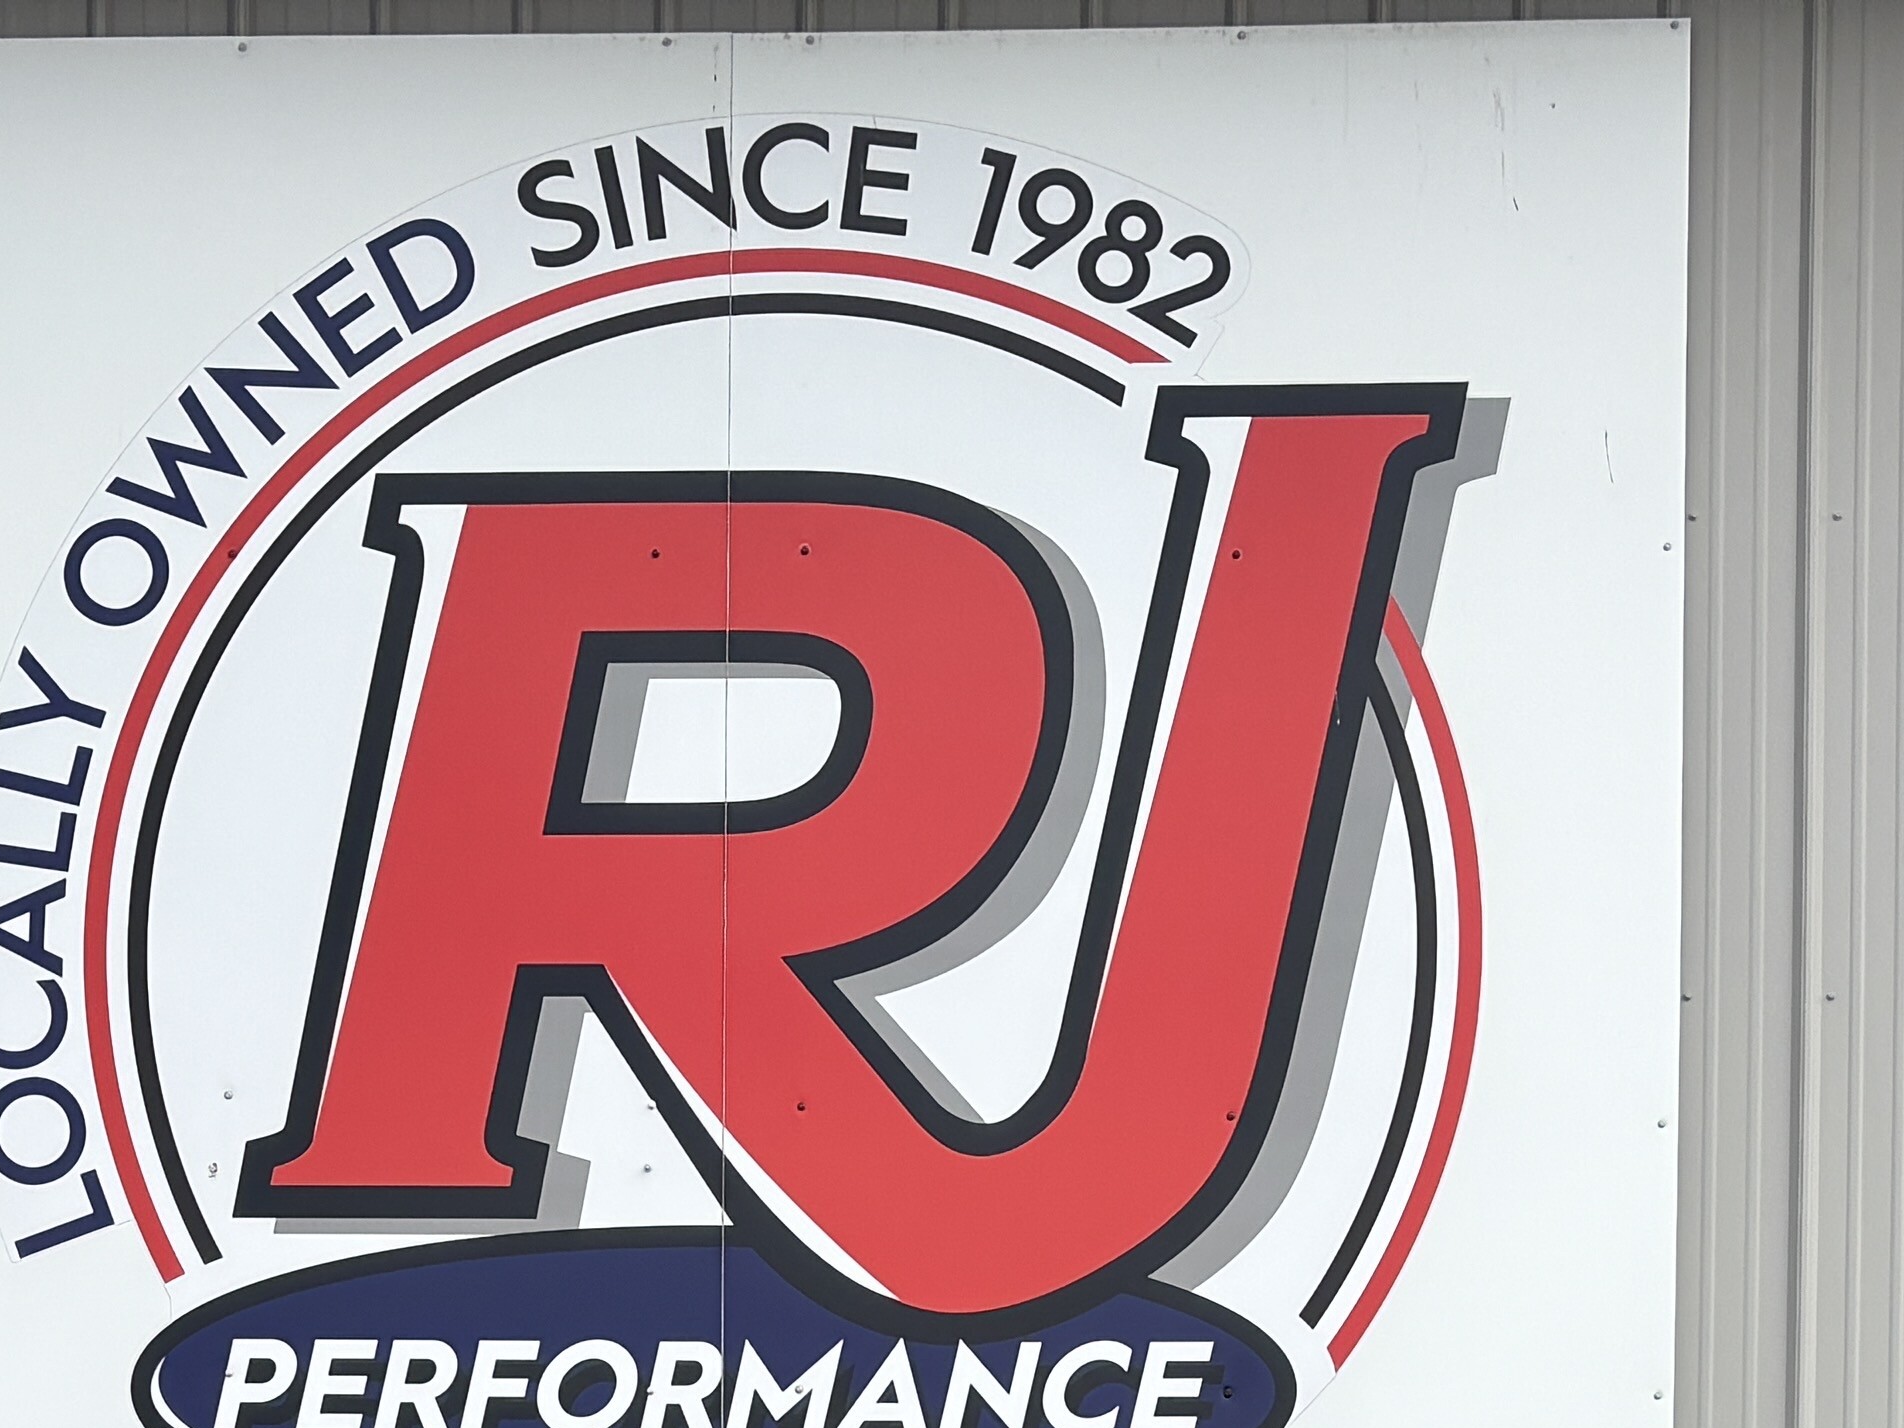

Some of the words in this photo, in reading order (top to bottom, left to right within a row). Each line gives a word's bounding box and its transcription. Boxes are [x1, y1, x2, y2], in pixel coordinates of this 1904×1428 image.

[63, 218, 476, 627] OWNED
[517, 122, 918, 268] SINCE
[971, 147, 1231, 349] 1982
[233, 381, 1470, 1342] RJ
